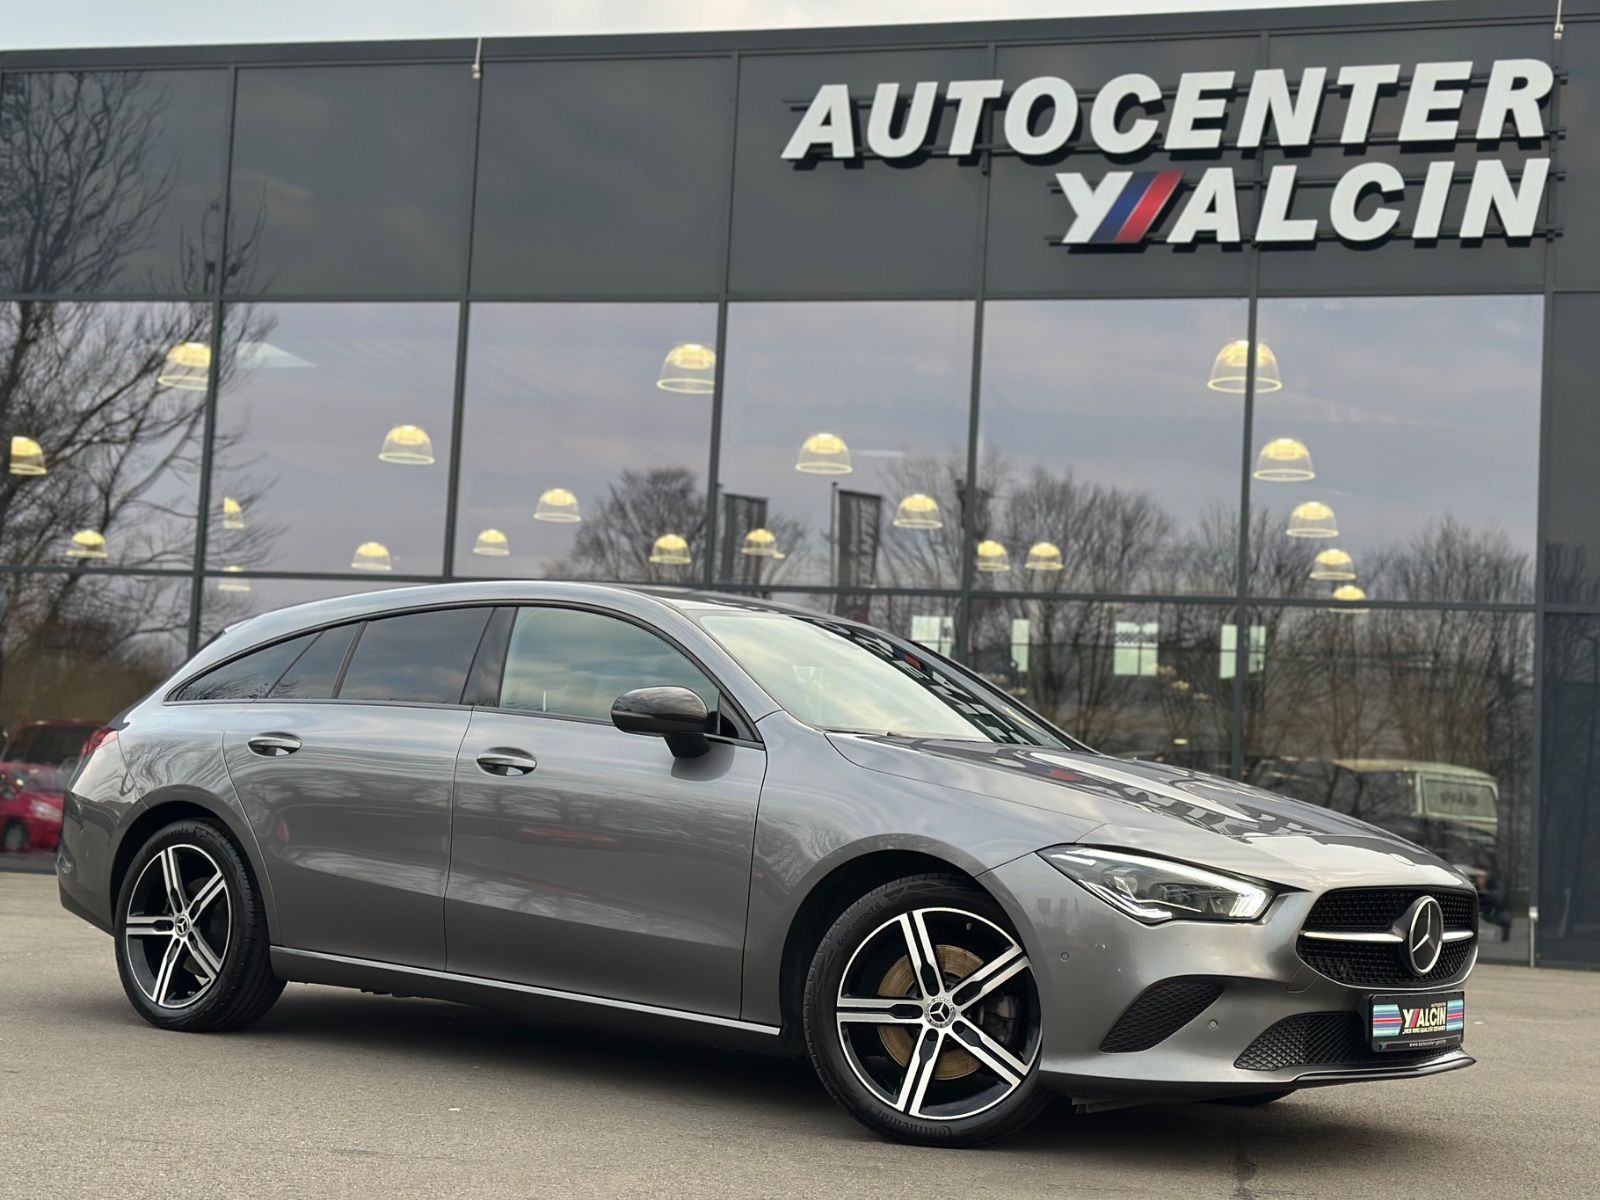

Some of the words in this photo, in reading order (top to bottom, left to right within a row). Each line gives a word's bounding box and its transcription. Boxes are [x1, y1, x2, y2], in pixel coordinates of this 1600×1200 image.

[781, 58, 1553, 158] AUTOCENTER
[1055, 158, 1550, 243] YALCIN
[1402, 1006, 1446, 1028] YALCIN
